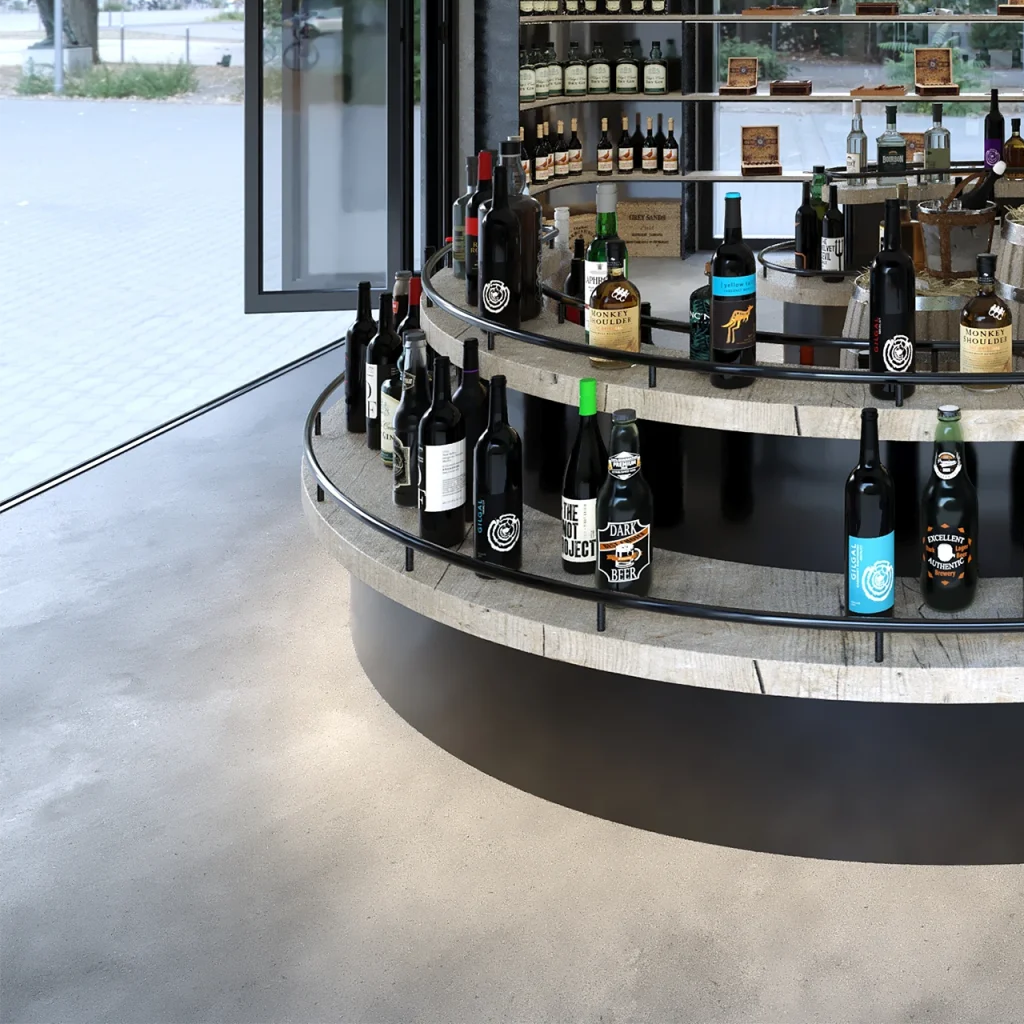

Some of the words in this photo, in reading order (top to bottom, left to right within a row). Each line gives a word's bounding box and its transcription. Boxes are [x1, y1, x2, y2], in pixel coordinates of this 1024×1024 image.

[591, 310, 628, 318] MONKEY
[965, 328, 1005, 337] MONKEY
[563, 502, 579, 522] THE
[610, 521, 637, 537] DARK
[927, 534, 965, 544] EXCELLENT
[927, 557, 965, 570] AUTHENTIC
[611, 567, 637, 581] BEER
[934, 569, 956, 577] Brewery
